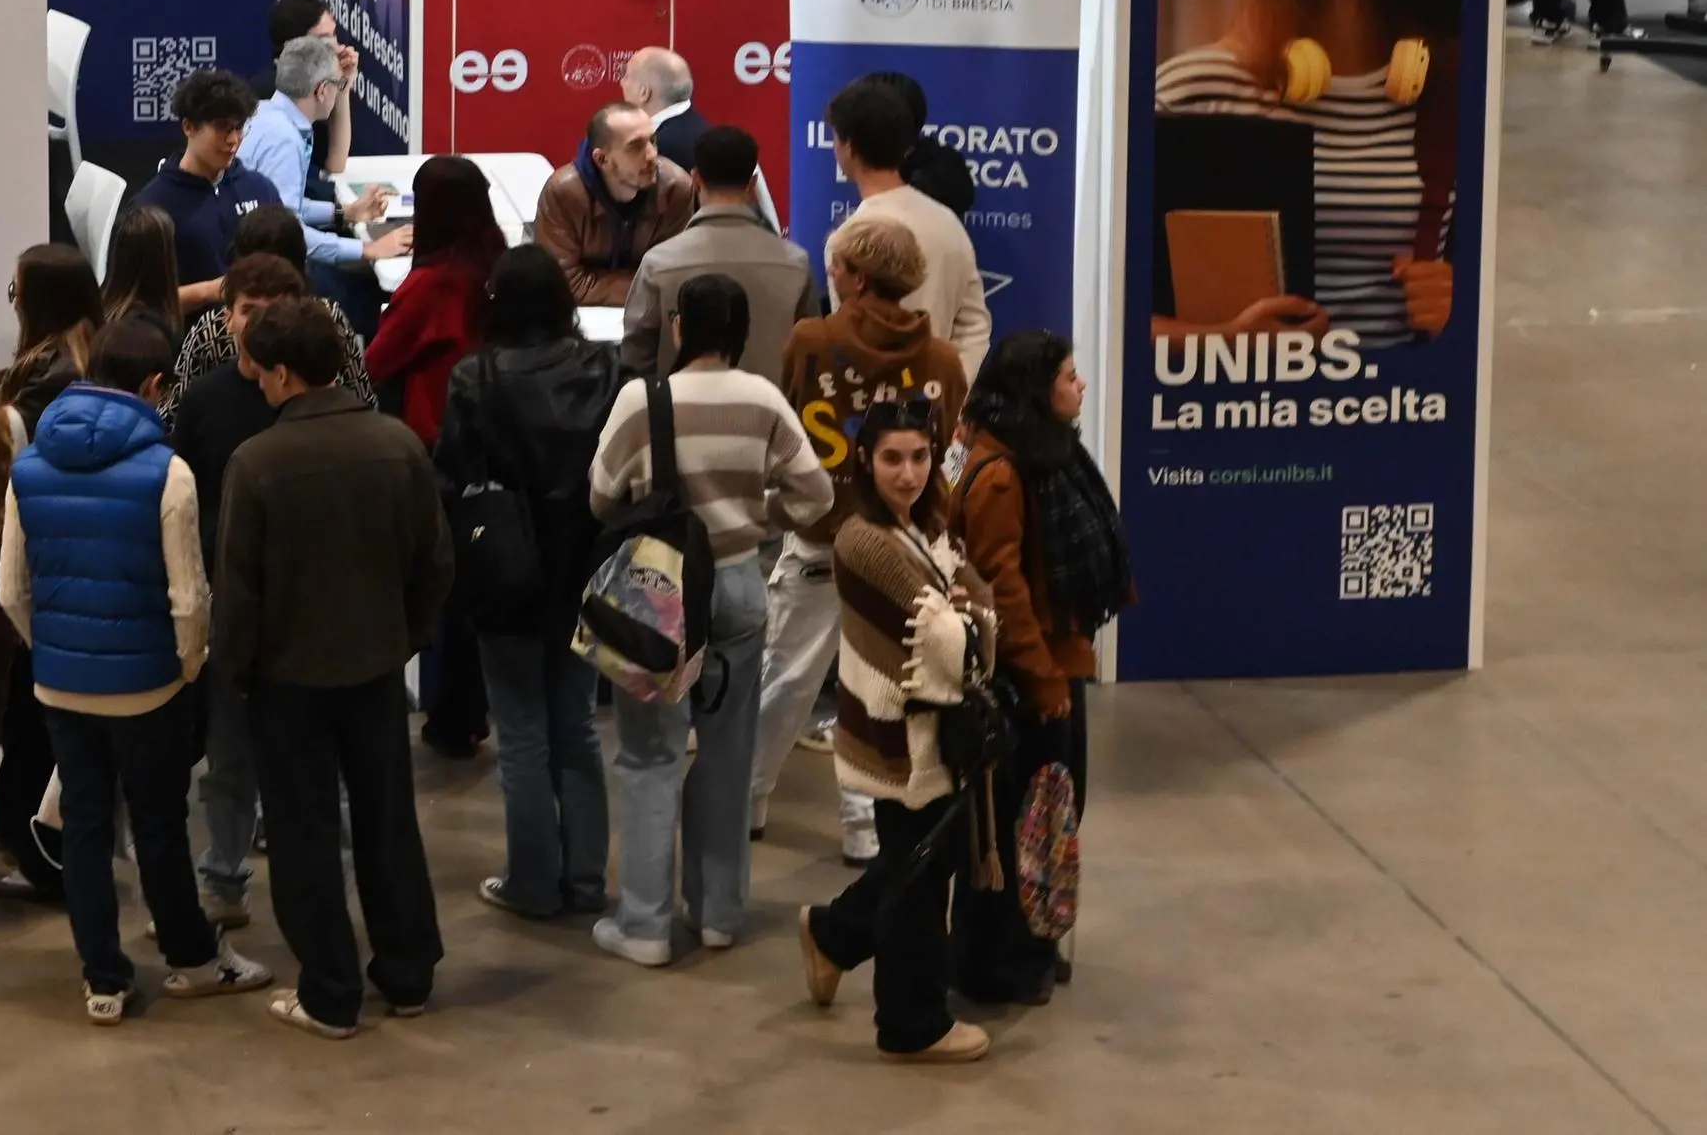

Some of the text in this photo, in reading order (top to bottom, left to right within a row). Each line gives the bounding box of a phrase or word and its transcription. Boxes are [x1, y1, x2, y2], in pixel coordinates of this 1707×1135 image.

[350, 5, 361, 43] di
[362, 16, 405, 82] Brescia
[367, 80, 380, 112] un
[382, 95, 410, 144] anno
[1154, 328, 1380, 386] UNIBS.
[1151, 386, 1447, 430] La mia scelta
[1148, 463, 1334, 486] Visita corsi.unibs.it
